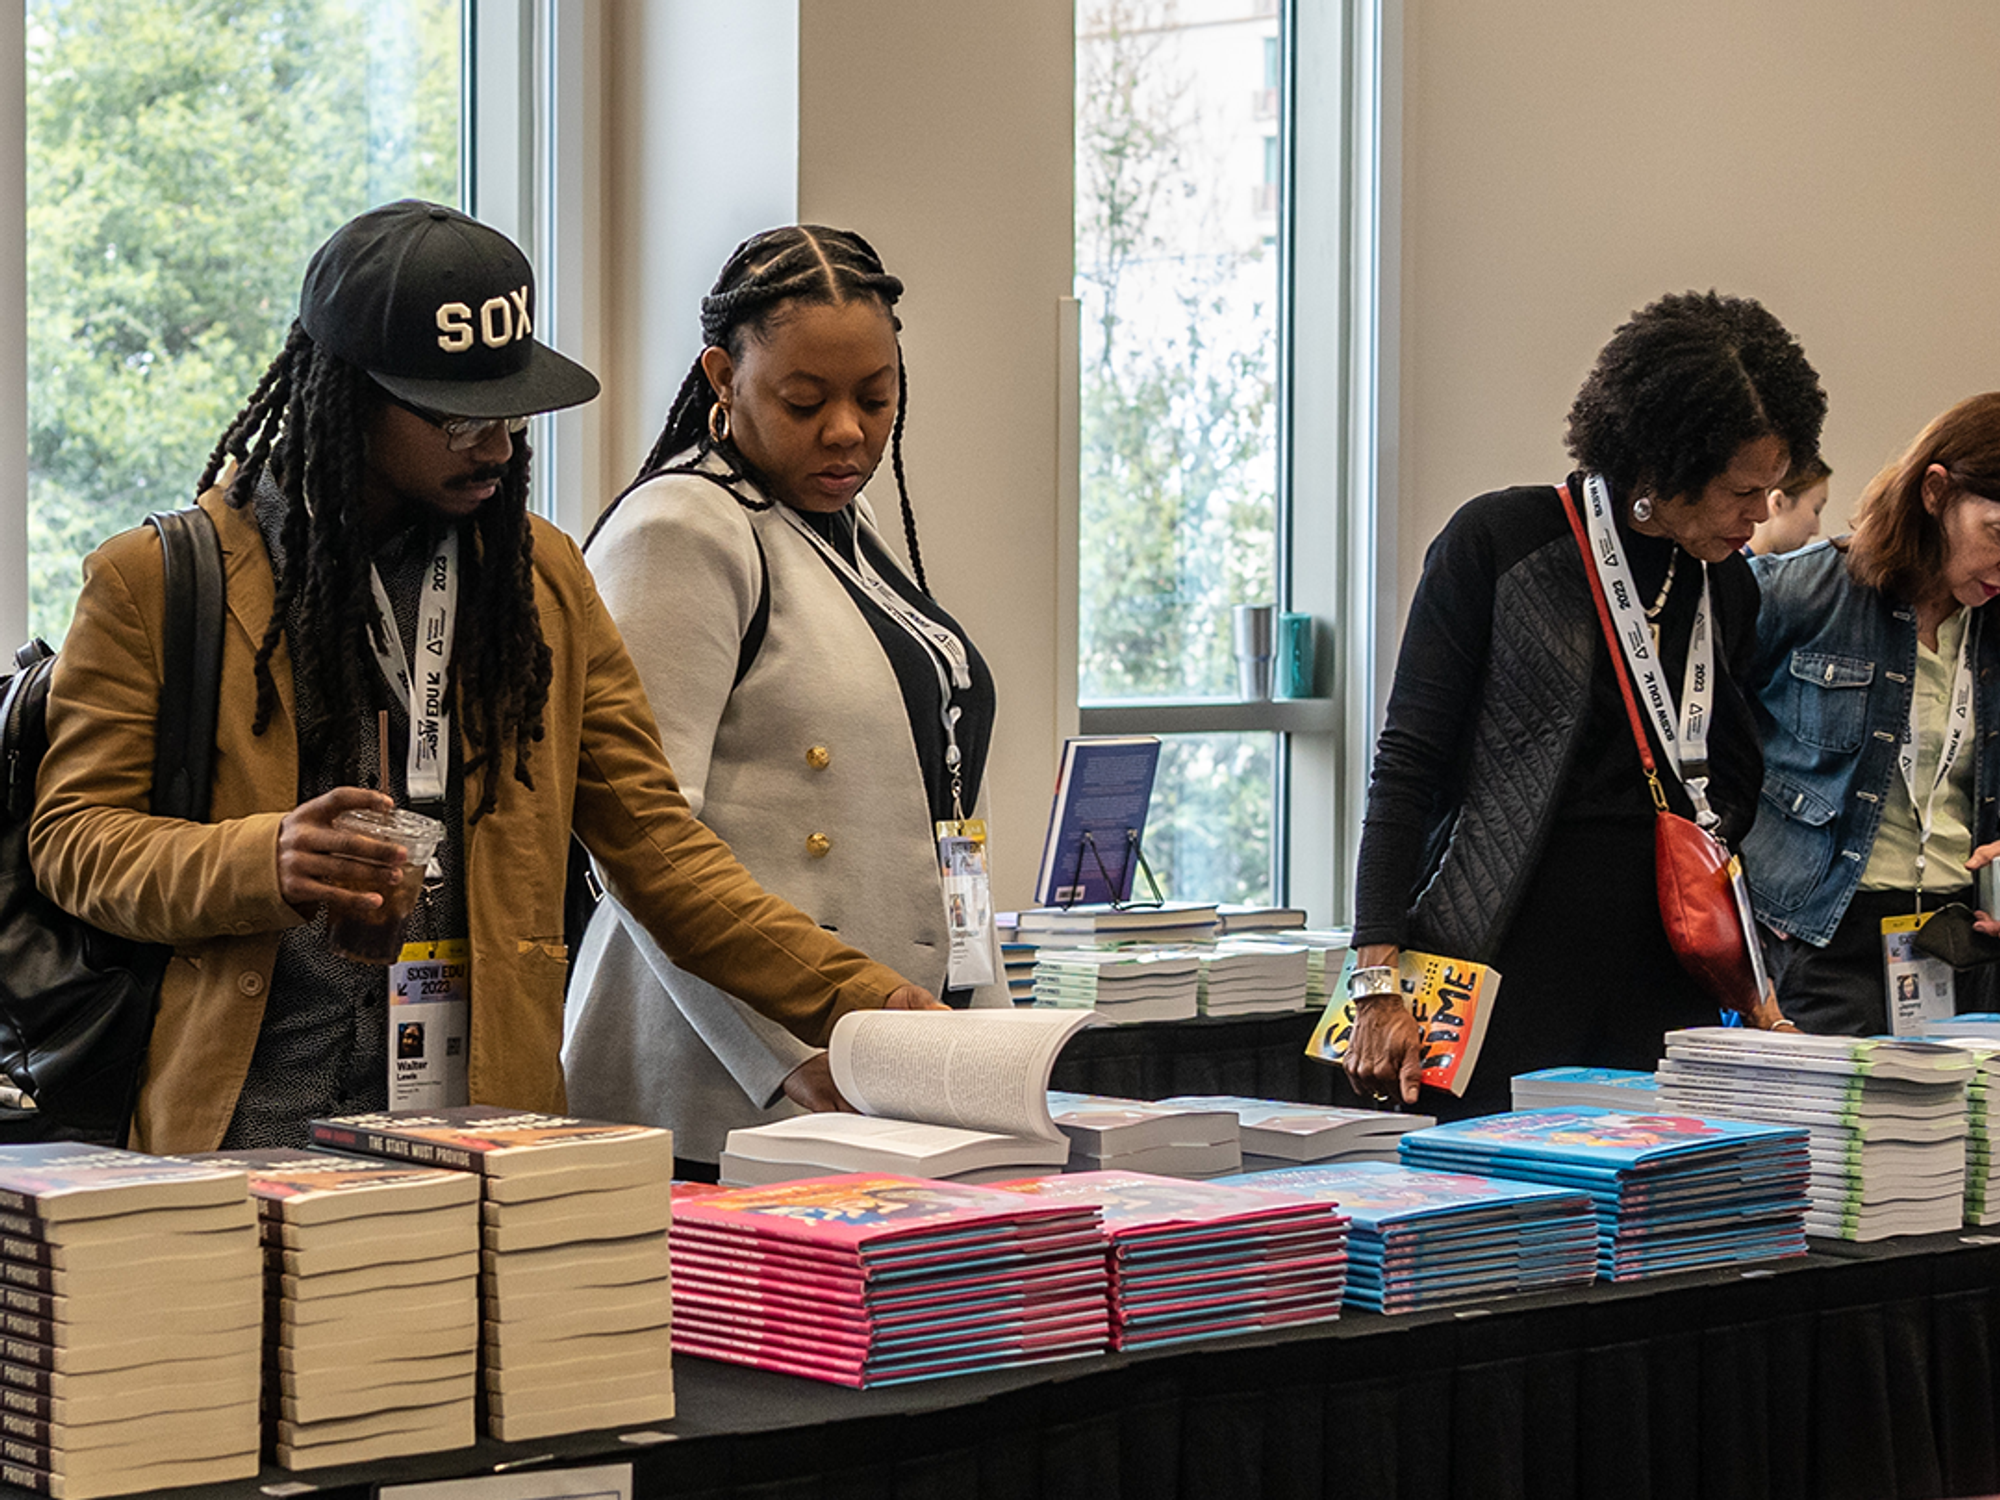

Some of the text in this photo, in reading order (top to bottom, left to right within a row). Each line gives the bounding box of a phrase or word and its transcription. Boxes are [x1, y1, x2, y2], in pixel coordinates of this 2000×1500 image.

[436, 285, 532, 353] SOX
[432, 555, 448, 592] 2023
[1612, 579, 1631, 611] 2023
[1693, 663, 1705, 693] 2023
[425, 687, 440, 717] EDU
[1647, 683, 1664, 709] EDU
[407, 965, 464, 981] SXSW EDU
[420, 980, 450, 995] 2023
[1420, 965, 1477, 1069] TIME
[368, 1134, 384, 1151] THE
[385, 1138, 409, 1157] STATE
[411, 1143, 434, 1160] MUST
[435, 1146, 471, 1168] PROVIDE
